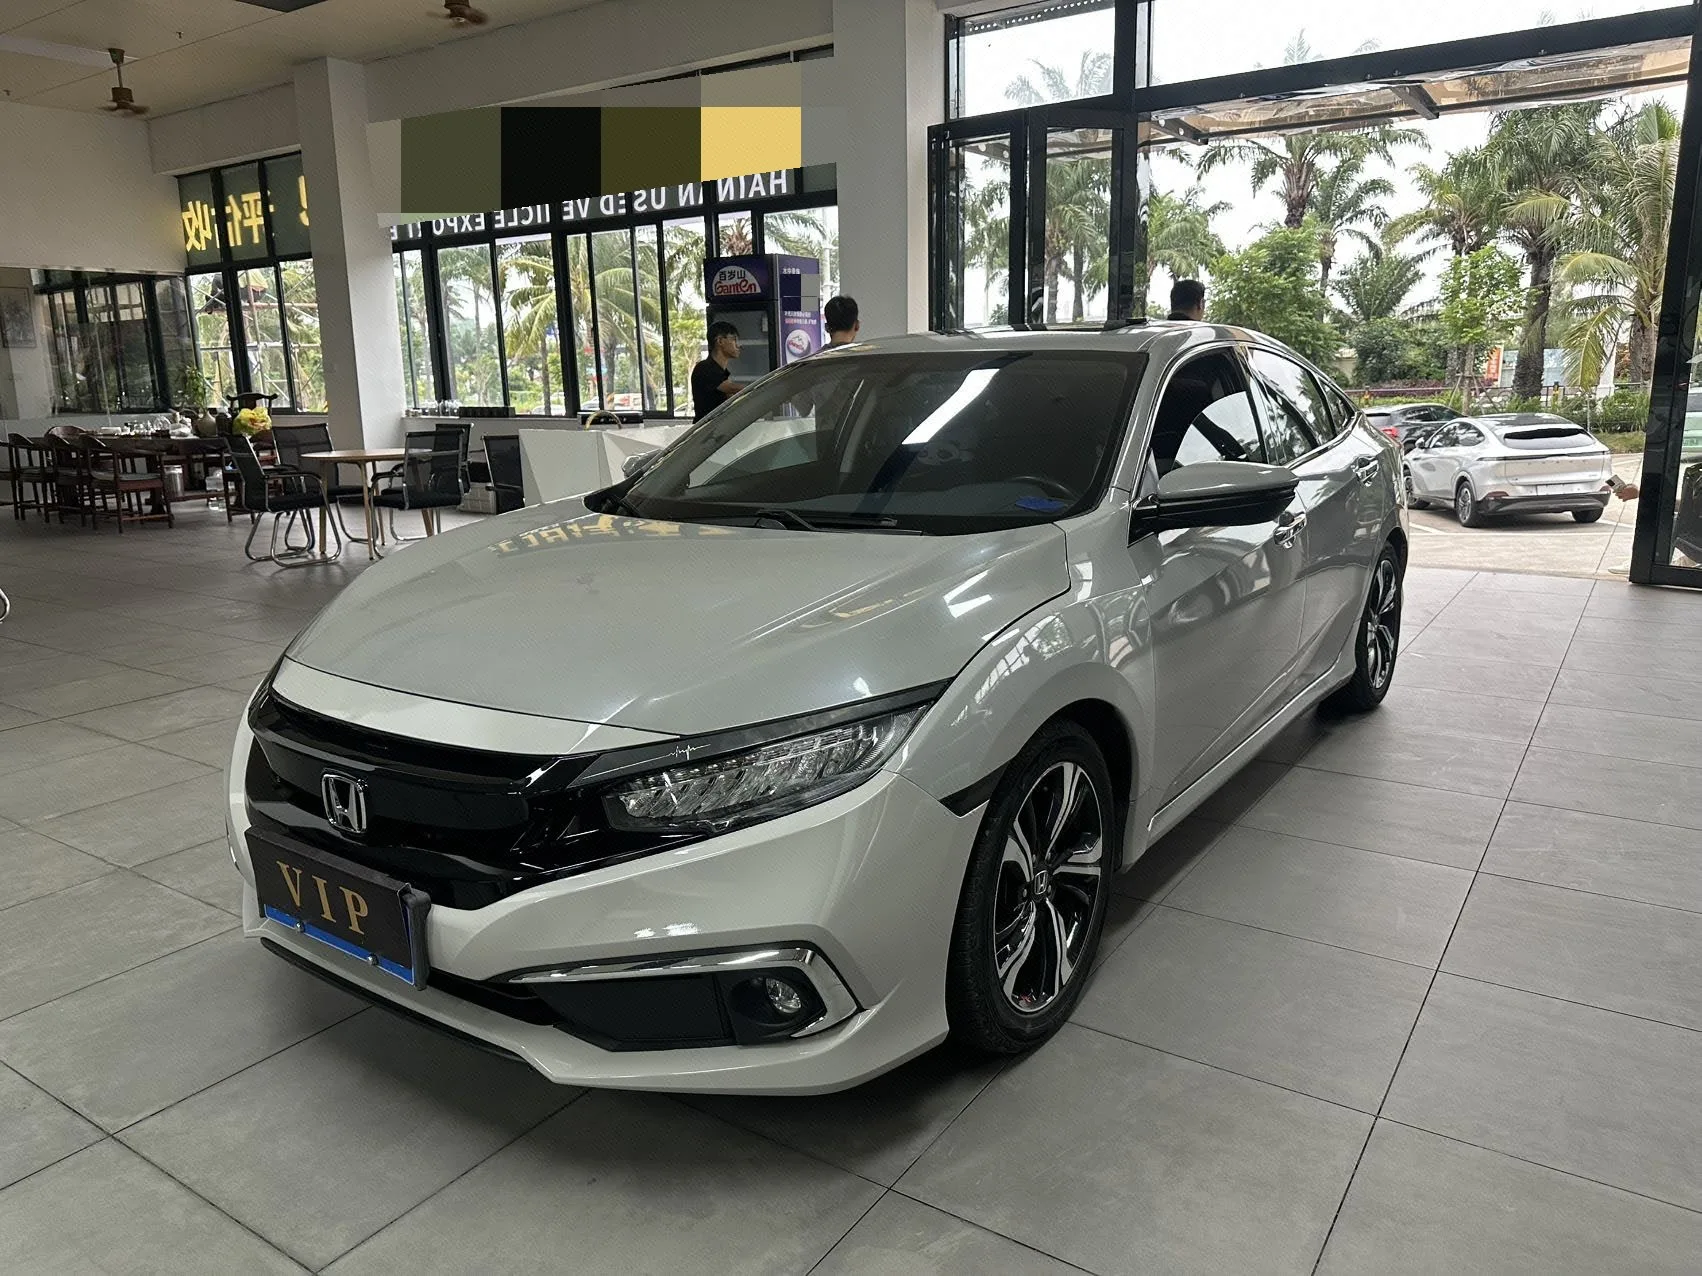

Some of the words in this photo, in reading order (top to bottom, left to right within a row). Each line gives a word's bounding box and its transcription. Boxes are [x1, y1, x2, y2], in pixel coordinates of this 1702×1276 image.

[719, 269, 746, 281] 百岁山
[276, 860, 369, 935] VIP
